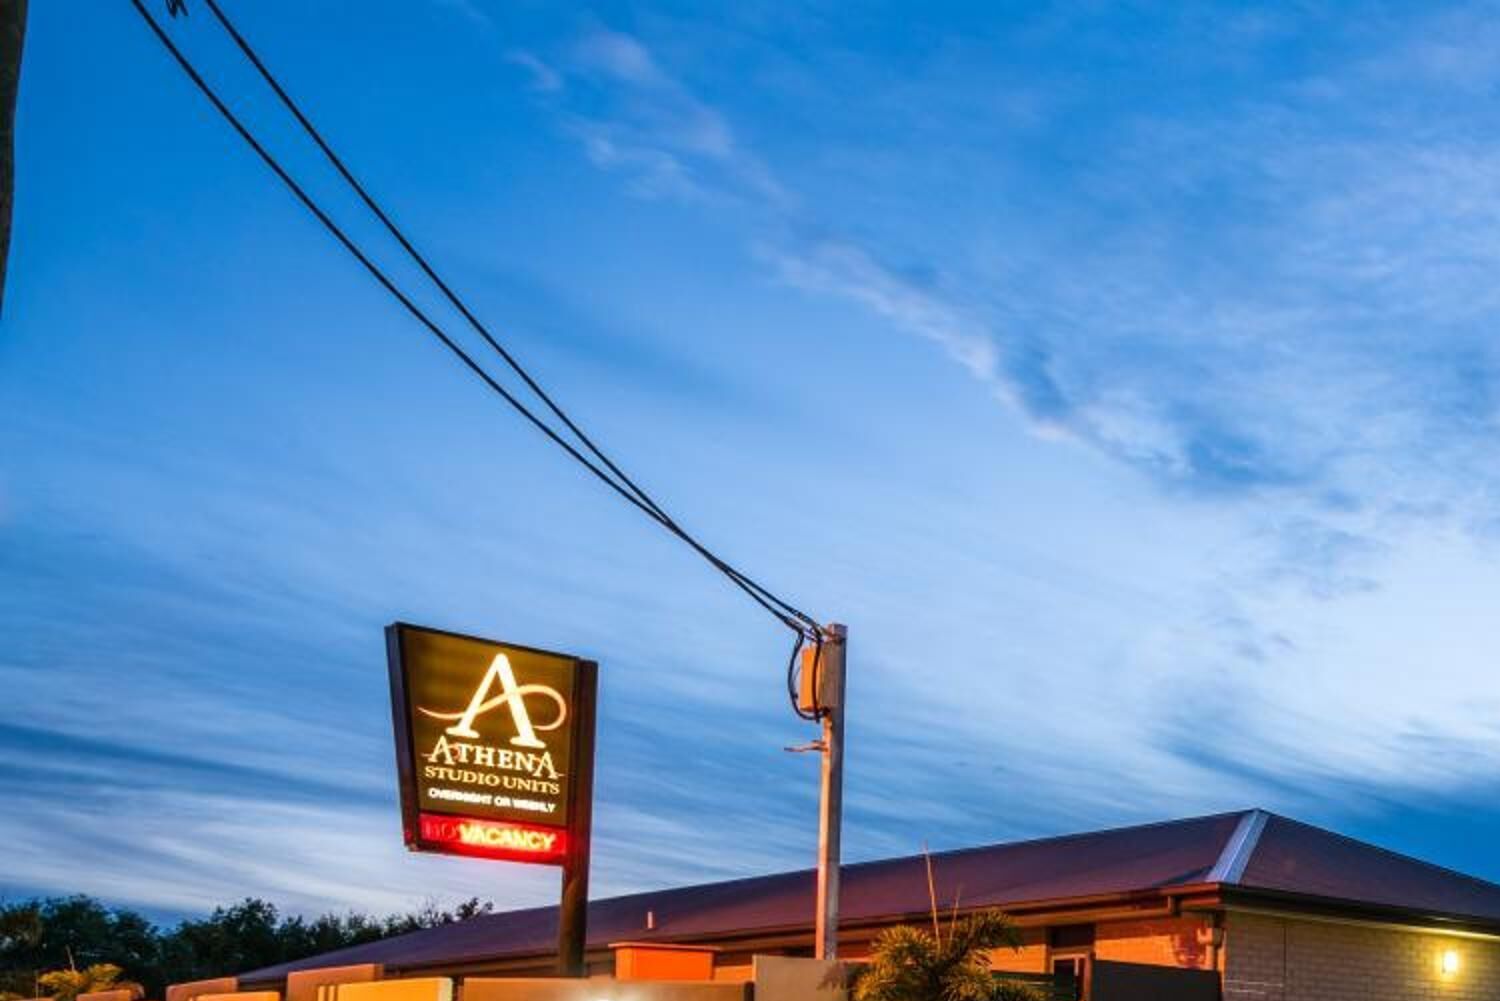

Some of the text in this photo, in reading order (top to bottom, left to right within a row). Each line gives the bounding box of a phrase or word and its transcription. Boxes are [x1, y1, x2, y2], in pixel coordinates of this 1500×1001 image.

[422, 735, 565, 779] ATHENA
[424, 765, 560, 794] STUDIO UNITS
[494, 794, 511, 808] OR
[460, 823, 556, 850] VACANCY
